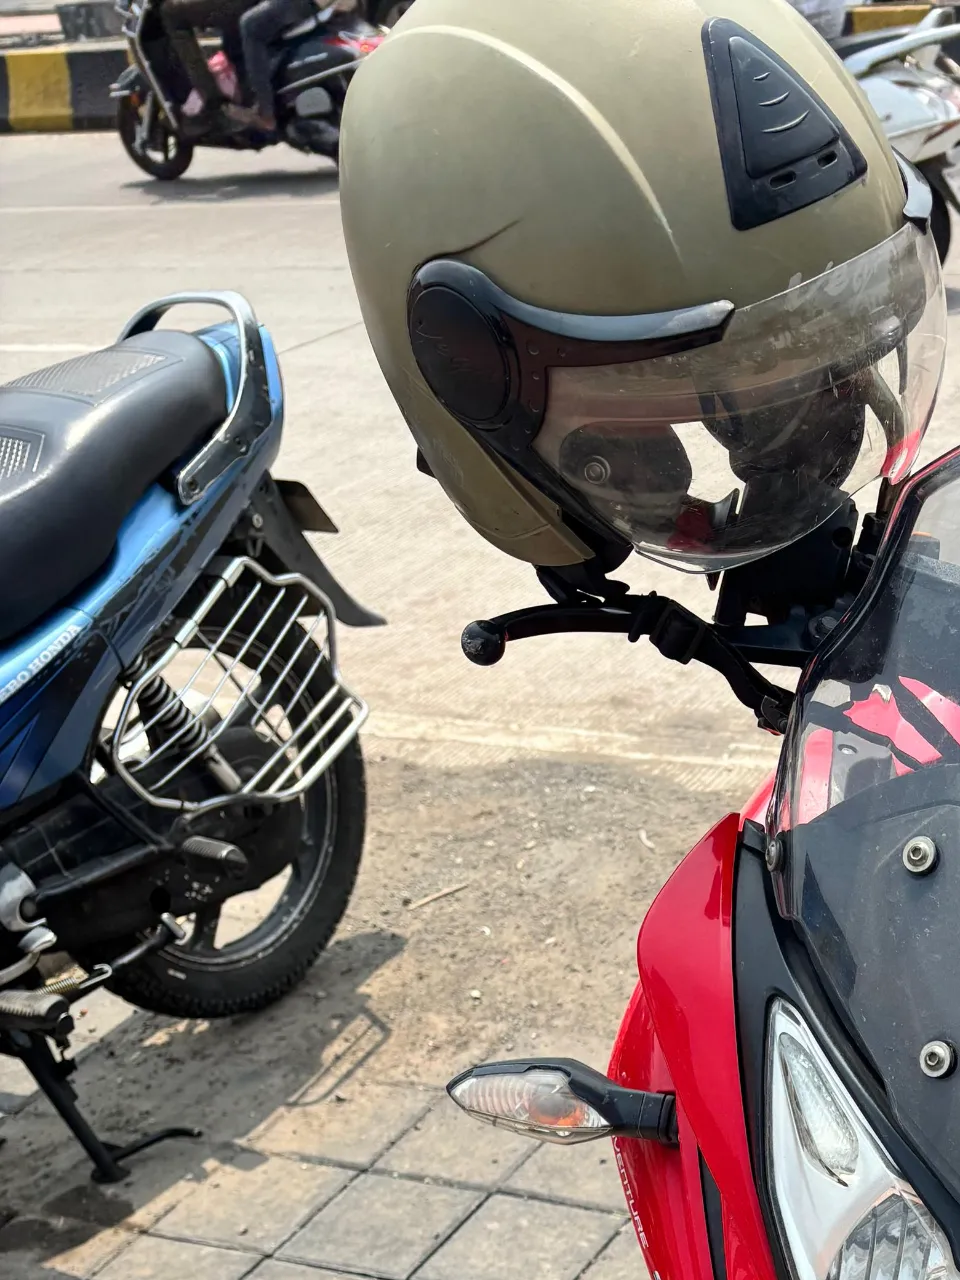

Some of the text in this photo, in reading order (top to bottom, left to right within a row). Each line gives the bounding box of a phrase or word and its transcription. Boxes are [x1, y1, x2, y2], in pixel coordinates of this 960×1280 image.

[0, 625, 82, 704] ERO HONDA
[611, 1135, 650, 1249] VENTURE
